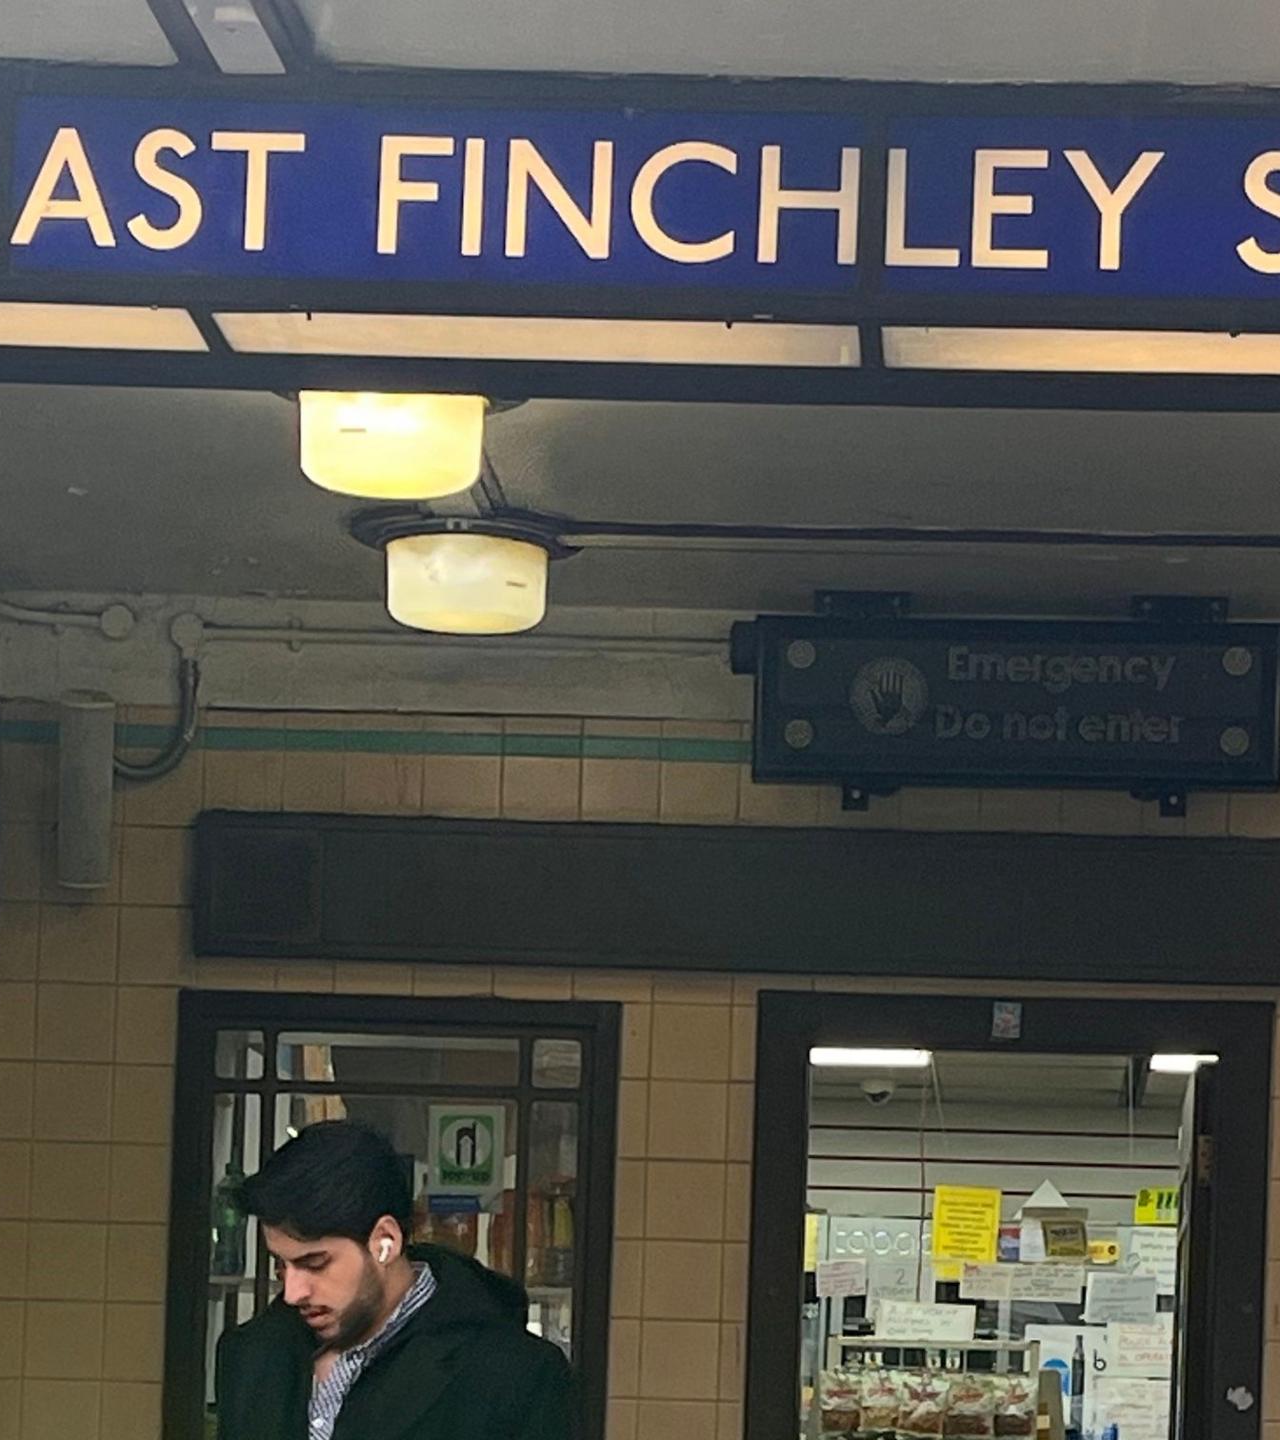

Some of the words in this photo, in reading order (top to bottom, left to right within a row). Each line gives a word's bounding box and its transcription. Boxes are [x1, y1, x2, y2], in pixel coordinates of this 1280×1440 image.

[376, 134, 1166, 271] FINCHLEY
[947, 646, 1177, 692] Emergency
[934, 705, 992, 740] Do
[1002, 708, 1069, 742] not
[1077, 711, 1185, 744] enter
